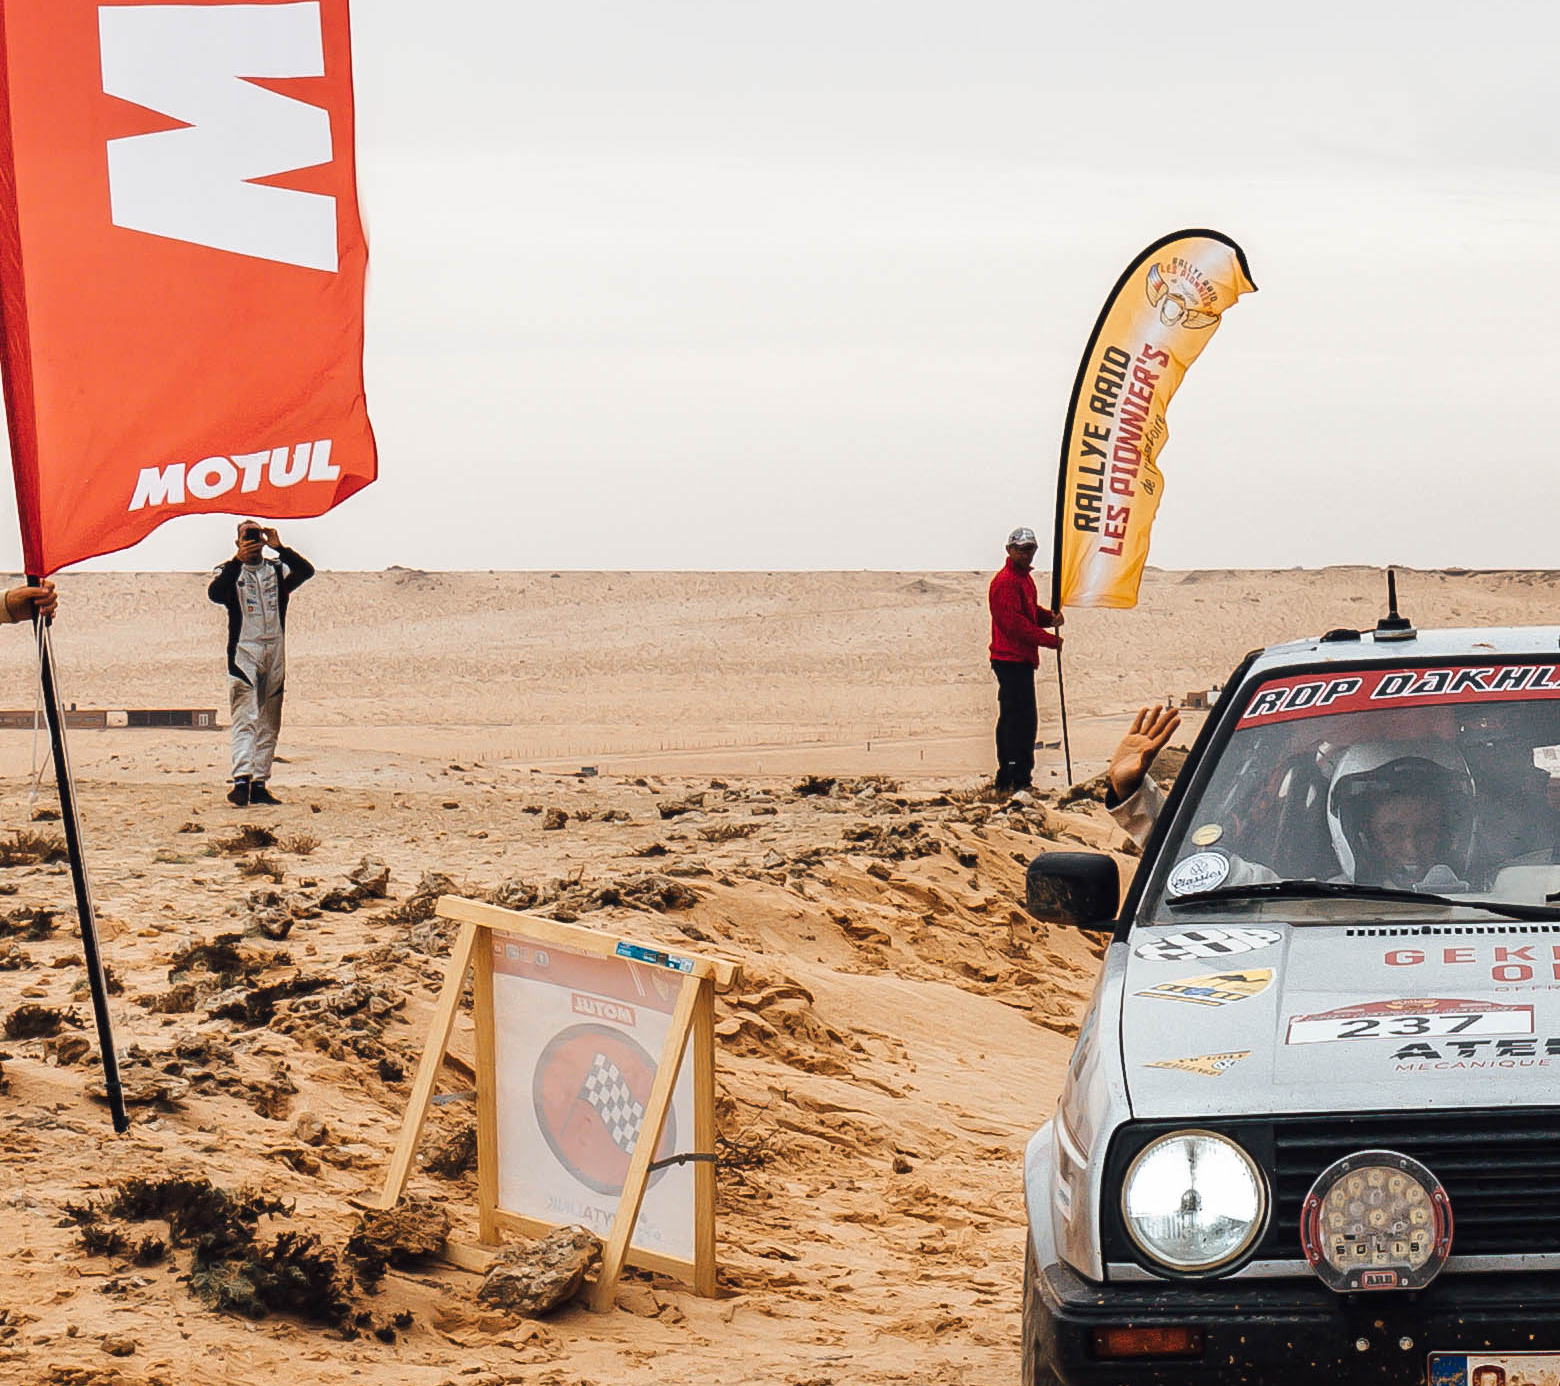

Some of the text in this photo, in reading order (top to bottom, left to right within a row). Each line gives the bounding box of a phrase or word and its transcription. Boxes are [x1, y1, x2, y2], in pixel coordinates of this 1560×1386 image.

[128, 439, 340, 511] MOTUL
[1073, 345, 1131, 533] RALLYE RAID
[1099, 343, 1169, 557] LES PIONNIER'S
[1337, 1014, 1483, 1038] 237
[1336, 1242, 1419, 1255] SOLIS
